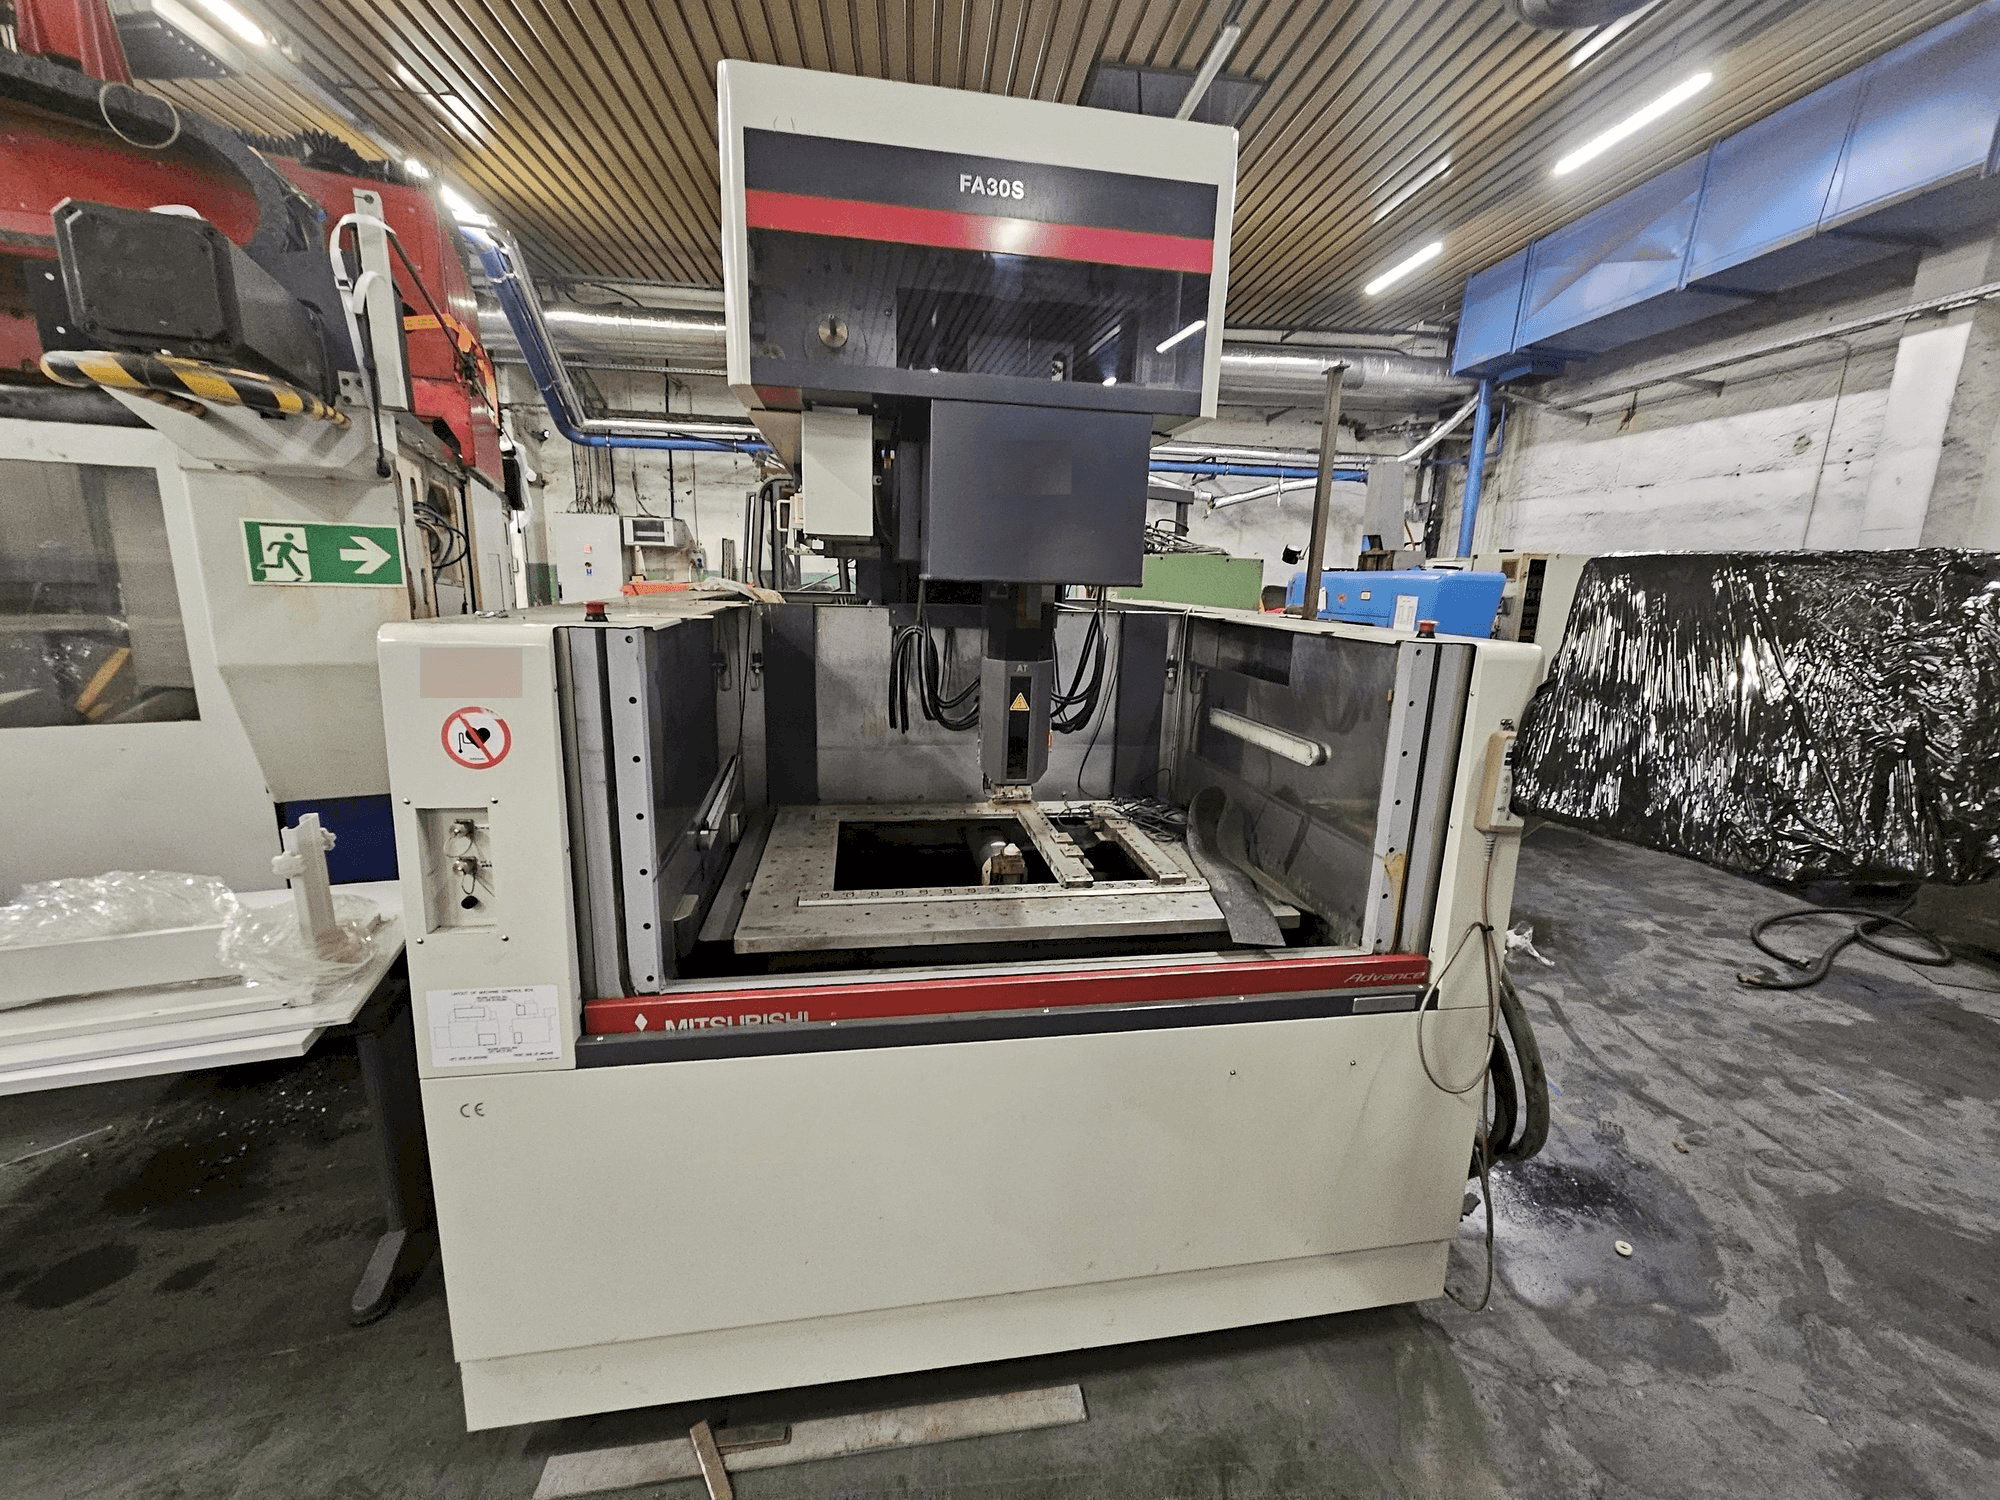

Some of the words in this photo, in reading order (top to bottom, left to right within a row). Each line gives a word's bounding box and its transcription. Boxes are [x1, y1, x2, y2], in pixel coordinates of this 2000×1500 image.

[960, 173, 1024, 199] FA30S
[1344, 972, 1426, 983] Advance
[460, 1102, 485, 1118] CE
